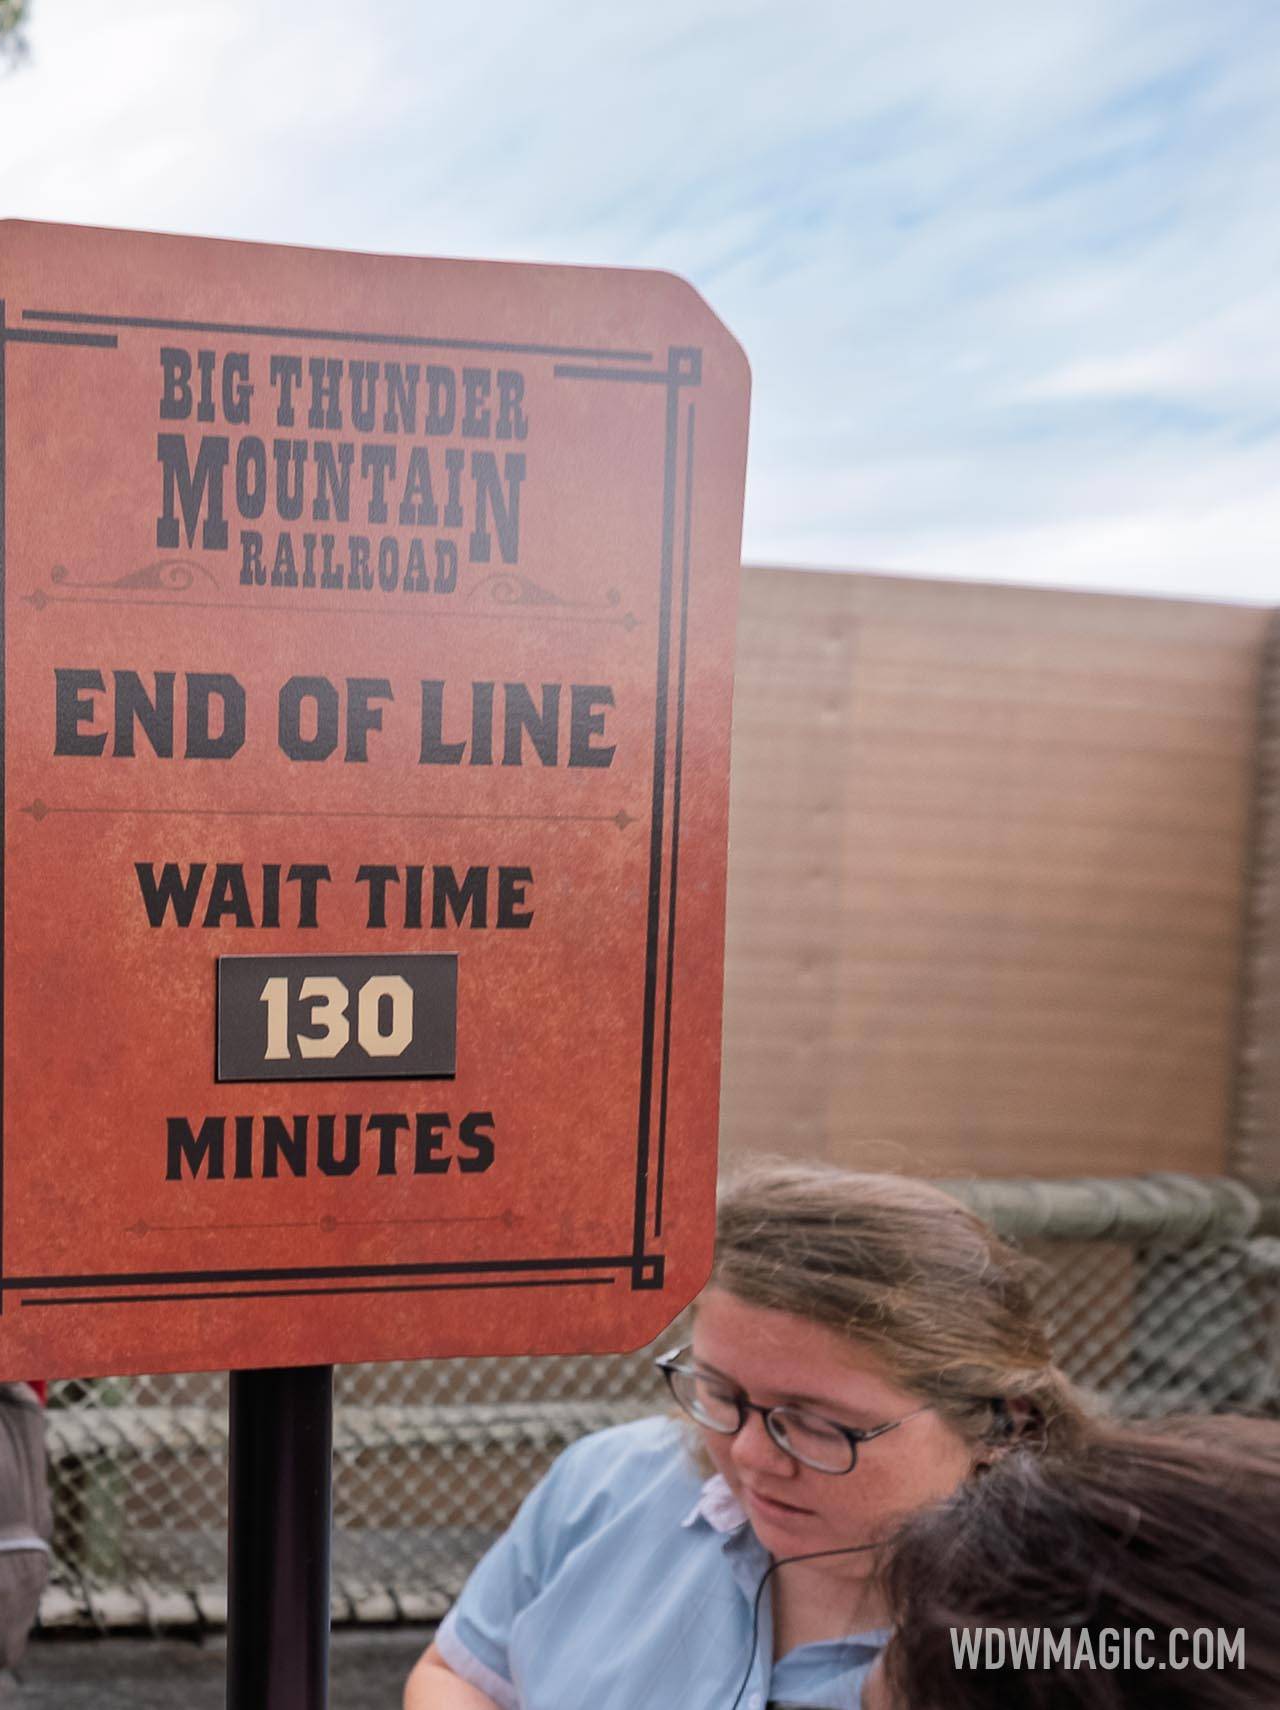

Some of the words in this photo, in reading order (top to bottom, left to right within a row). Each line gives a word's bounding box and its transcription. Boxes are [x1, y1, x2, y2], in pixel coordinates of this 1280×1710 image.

[160, 347, 254, 425] BIG
[270, 355, 528, 440] THUNDER
[156, 433, 526, 564] MOUNTAIN
[240, 530, 458, 594] RAILROAD
[53, 668, 247, 760] END
[277, 675, 394, 764] OF
[418, 679, 618, 769] LINE
[134, 862, 332, 929] WAIT
[355, 864, 534, 930] TIME
[259, 975, 414, 1060] 130
[165, 1111, 495, 1181] MINUTES
